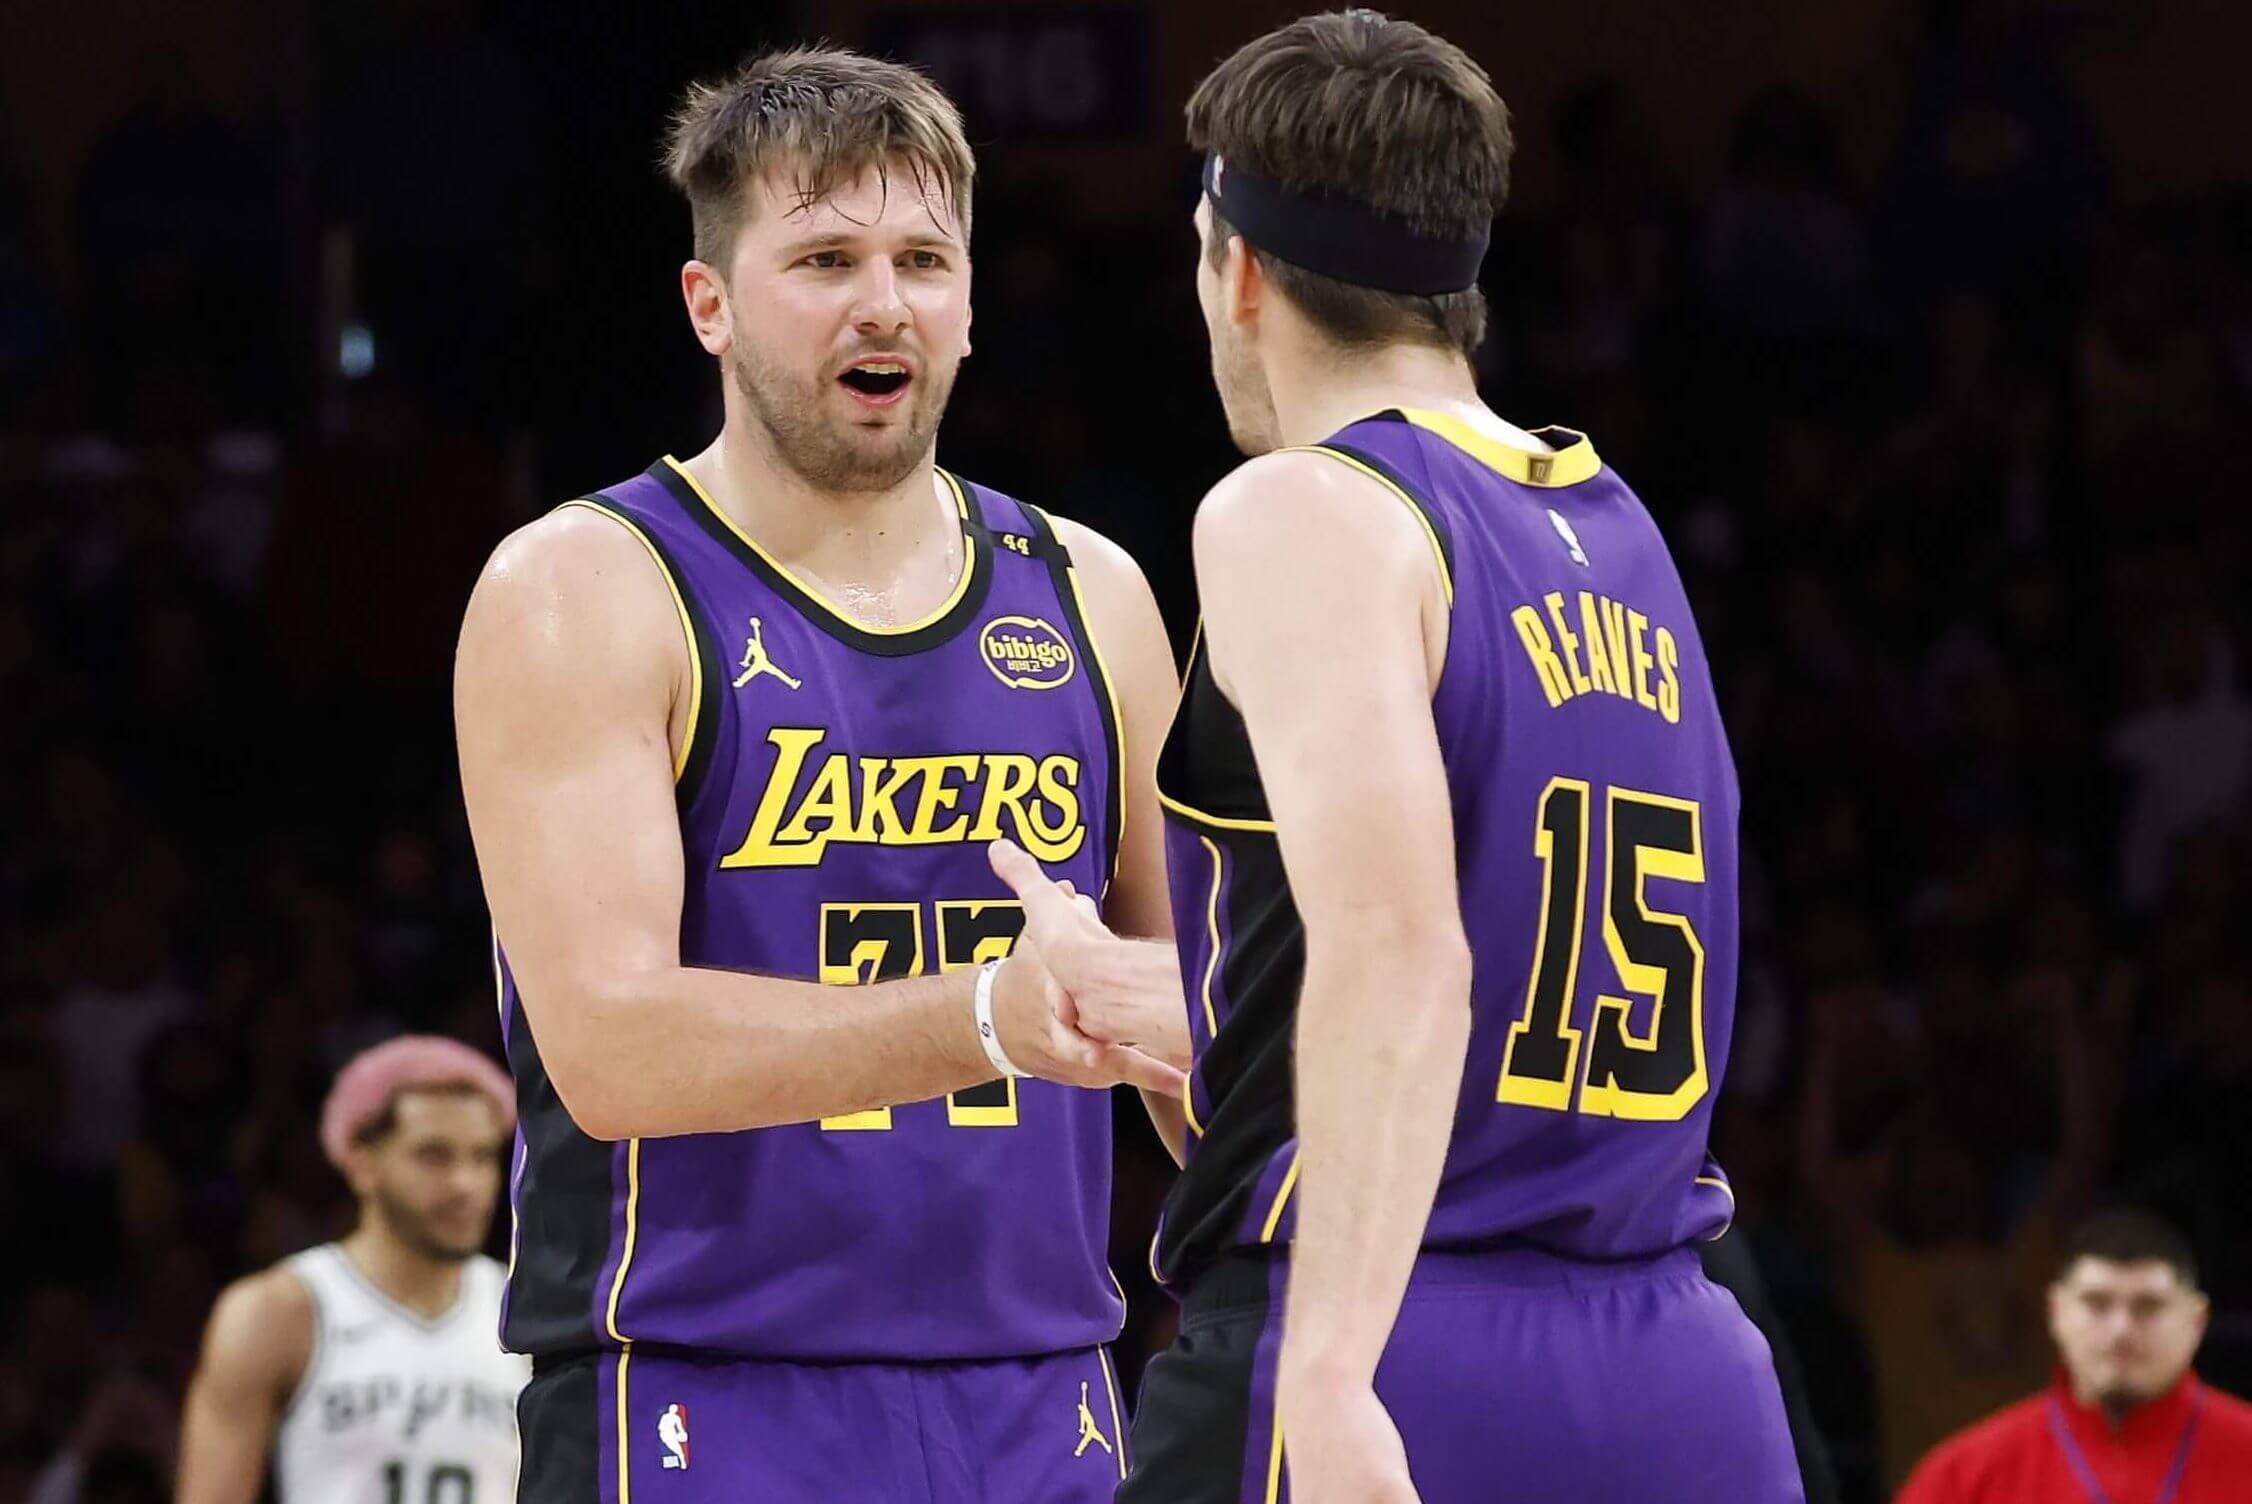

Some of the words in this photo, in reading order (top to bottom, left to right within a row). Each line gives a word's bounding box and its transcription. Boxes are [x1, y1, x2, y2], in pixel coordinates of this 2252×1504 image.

[1002, 533, 1031, 556] 44
[987, 634, 1067, 669] bibigo
[1509, 590, 1681, 724] REAVES
[718, 727, 1086, 868] LAKERS
[1495, 775, 1710, 1122] 15
